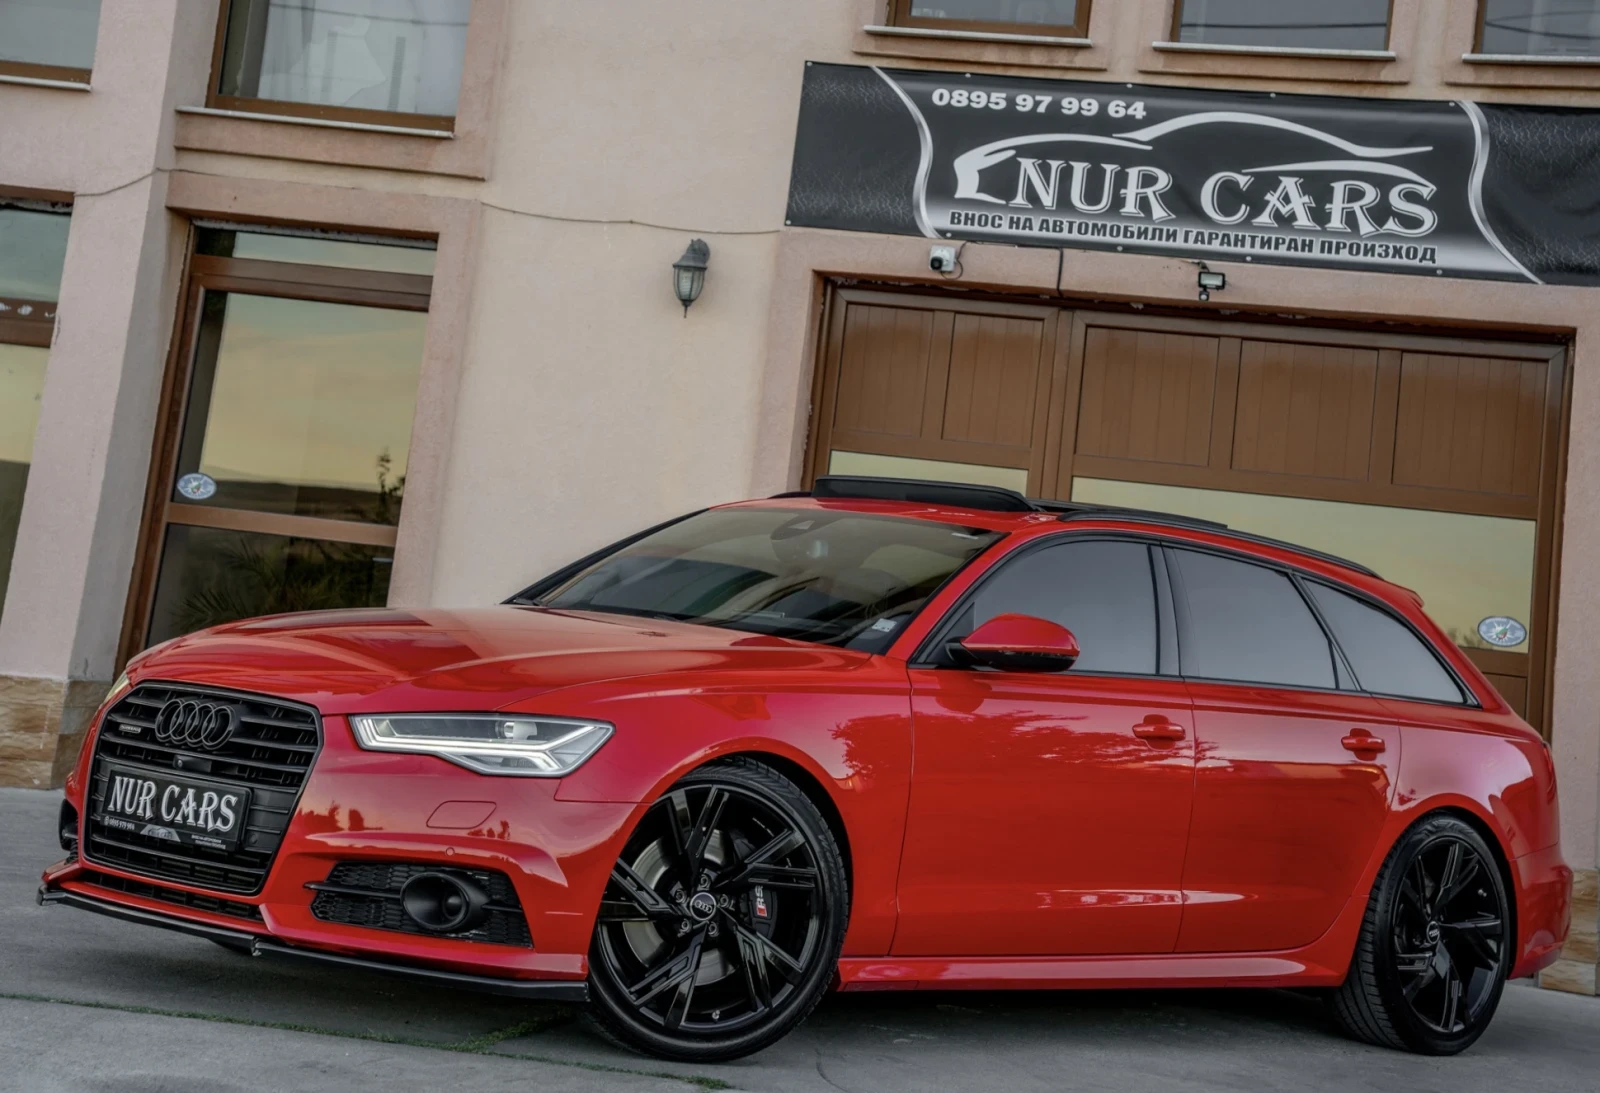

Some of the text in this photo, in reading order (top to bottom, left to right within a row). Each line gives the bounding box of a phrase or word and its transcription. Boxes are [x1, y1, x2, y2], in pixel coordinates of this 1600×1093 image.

[932, 88, 1146, 119] 0895 97 99 64
[1008, 157, 1438, 238] NUR CARS
[950, 211, 1437, 264] ВНОС НА АВТОМОБИЛИ ГАРАНТИРАН ПРОИЗХОД
[107, 775, 238, 832] NUR CARS
